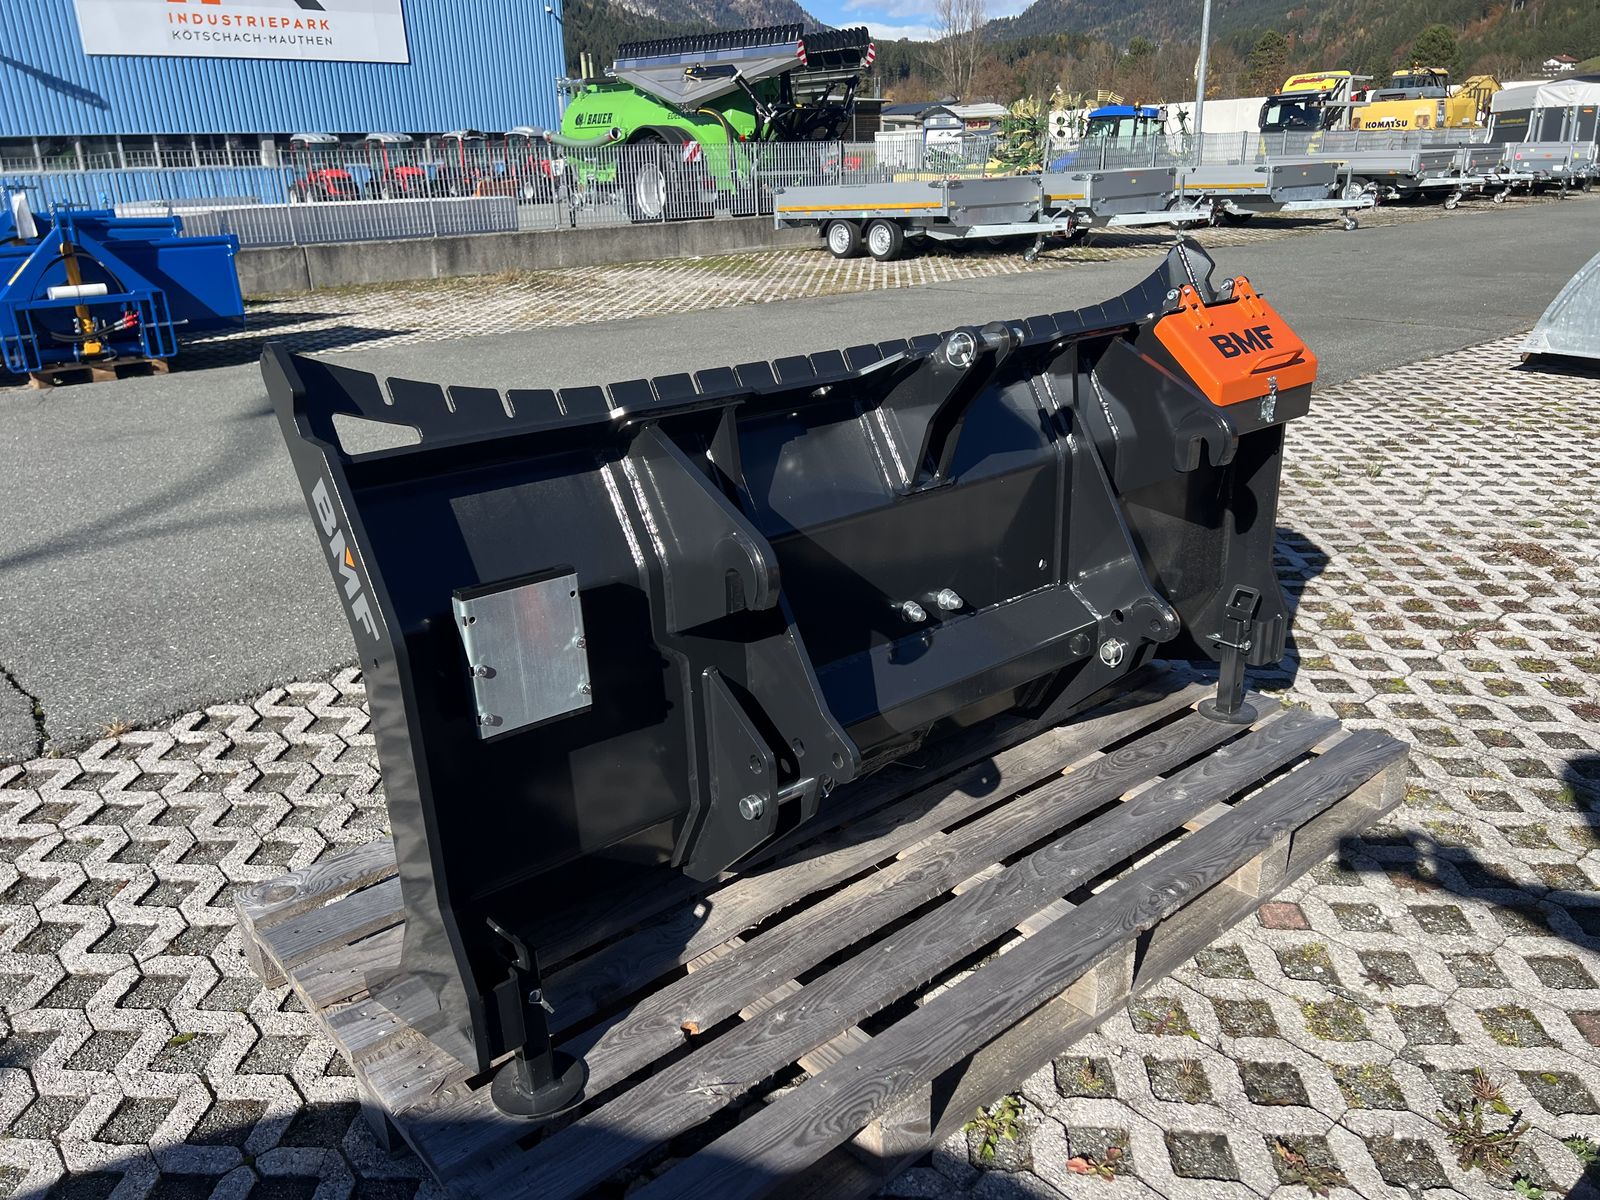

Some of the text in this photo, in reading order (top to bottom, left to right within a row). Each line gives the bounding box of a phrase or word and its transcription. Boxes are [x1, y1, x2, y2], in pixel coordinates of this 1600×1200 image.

[168, 12, 330, 31] INDUSTRIEPARK
[172, 30, 334, 46] KÖTSCHACH-MAUTHEN
[587, 112, 613, 125] BAUER
[1365, 119, 1408, 129] KOMATSU
[1208, 325, 1275, 359] BMF
[311, 476, 381, 641] BMF
